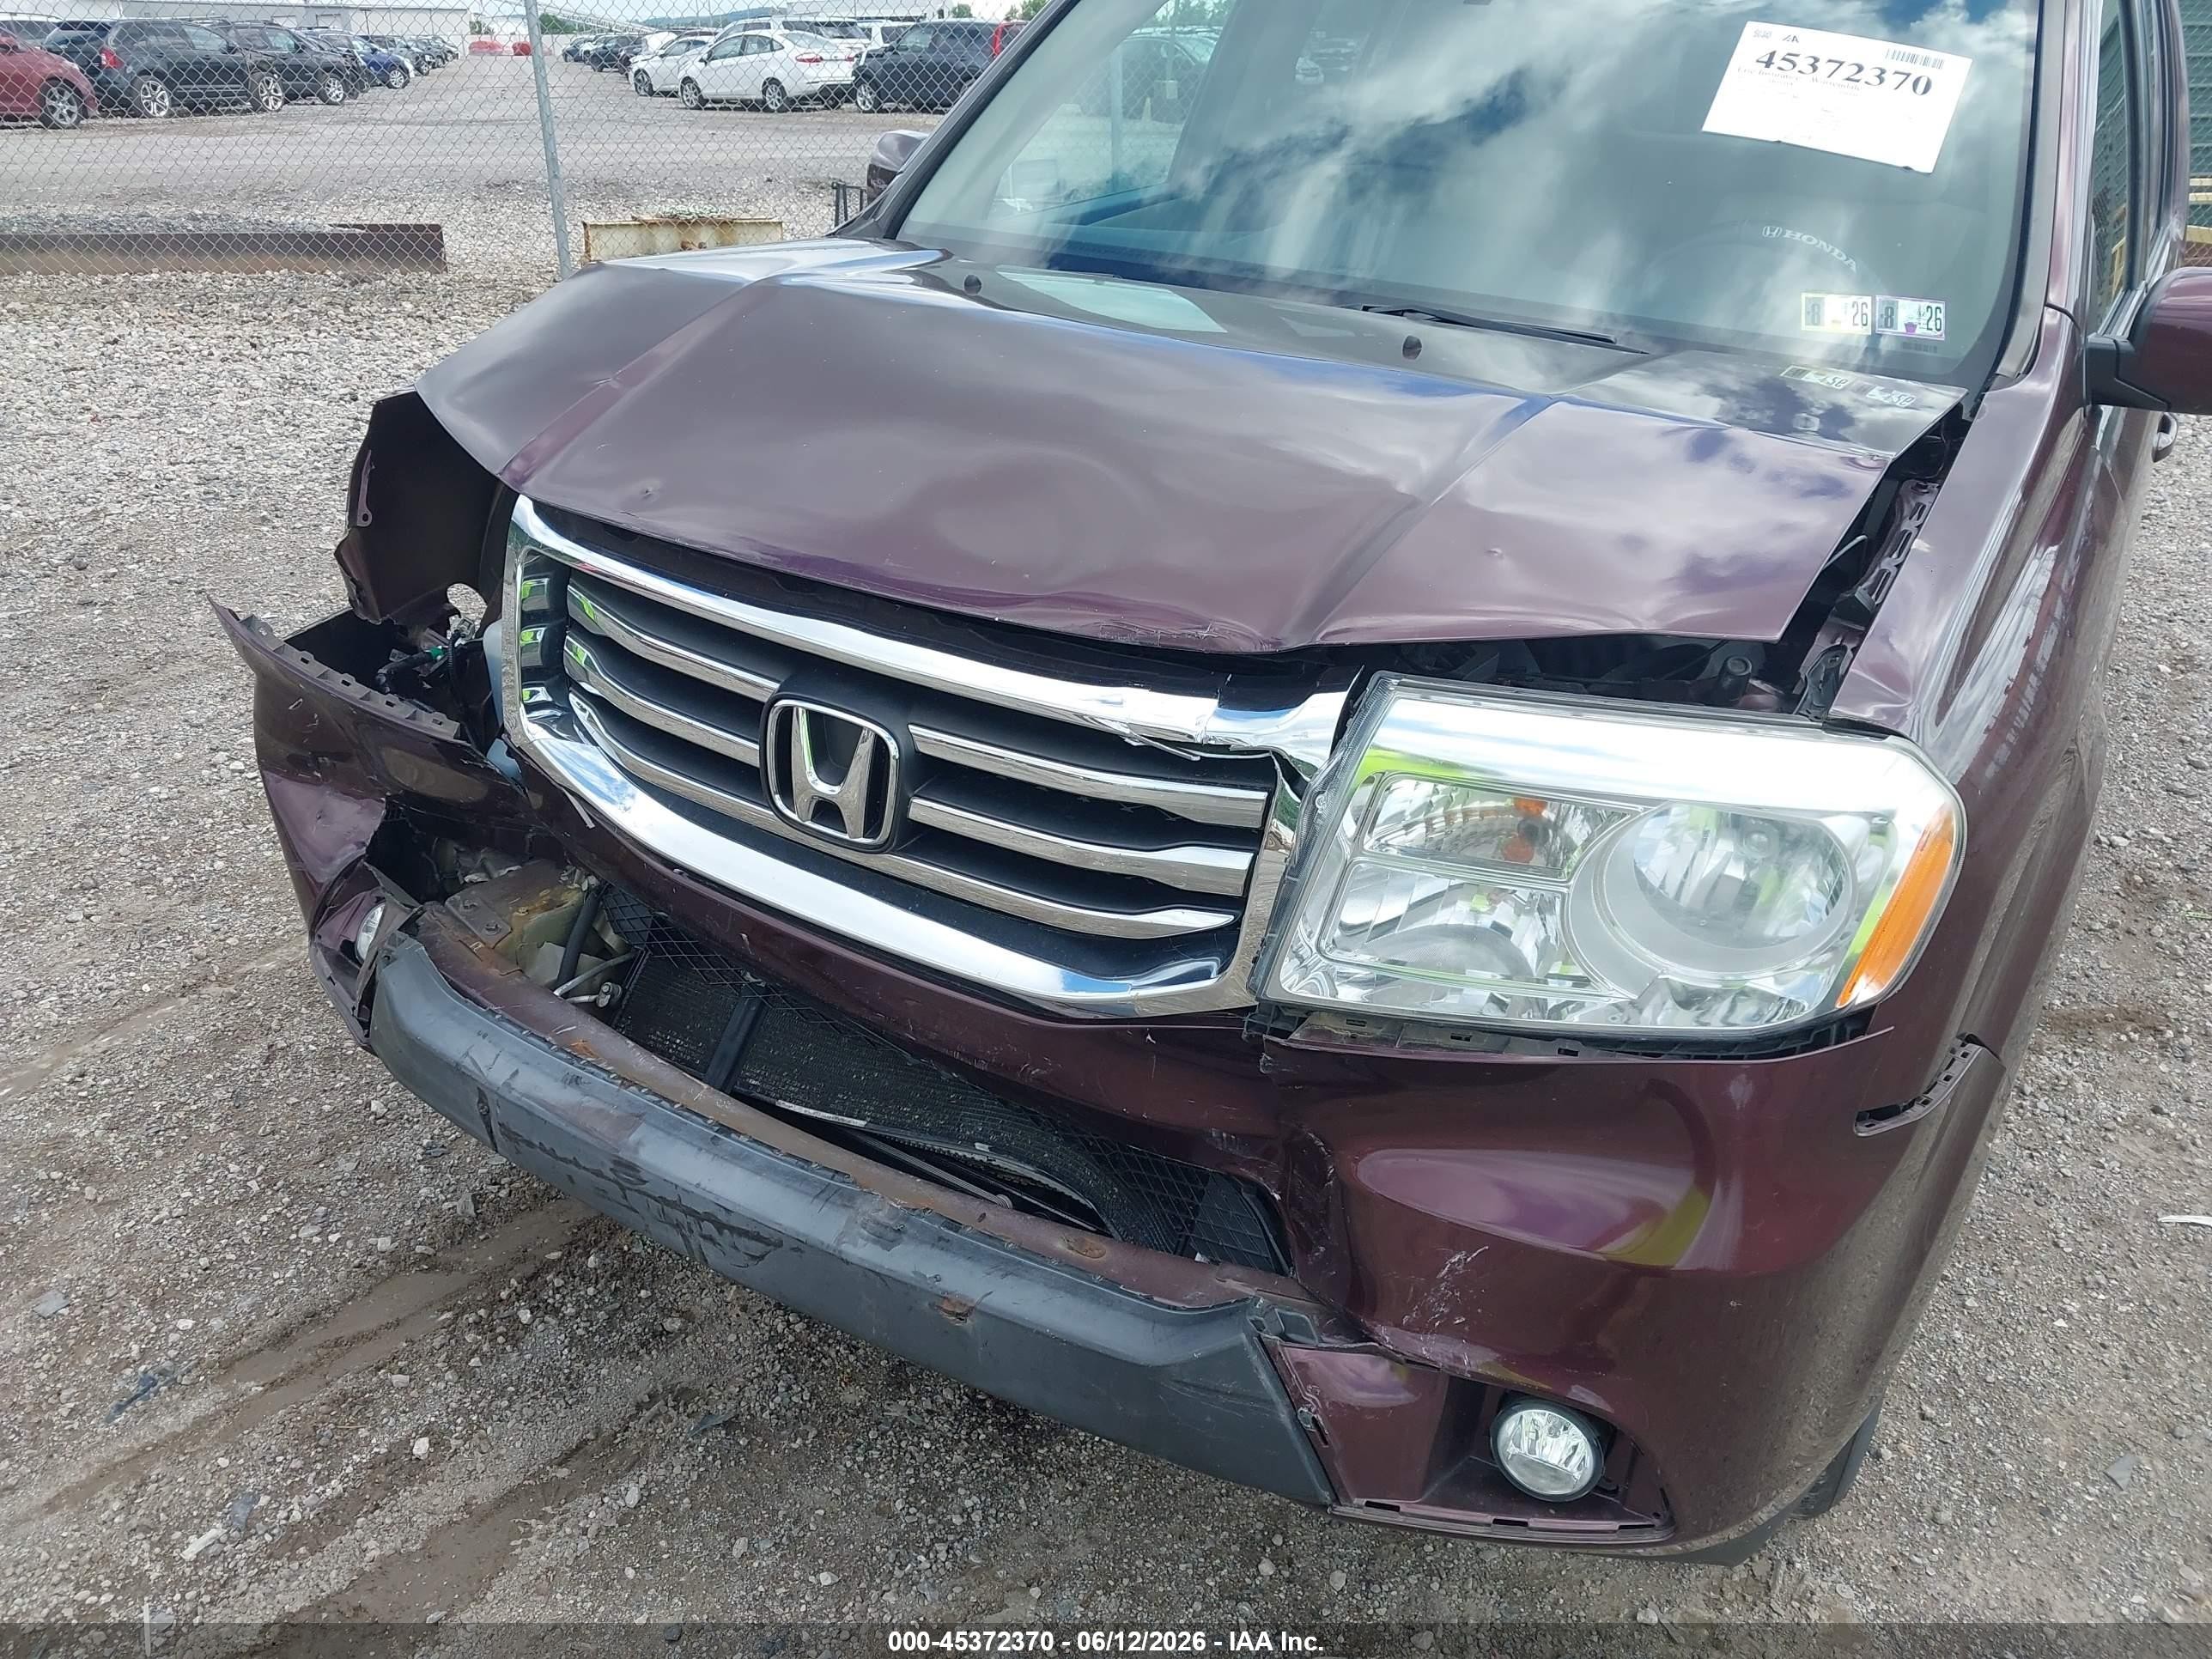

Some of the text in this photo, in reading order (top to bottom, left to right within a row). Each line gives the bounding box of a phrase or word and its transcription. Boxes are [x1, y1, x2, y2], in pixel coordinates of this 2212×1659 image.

[1755, 49, 1933, 96] 45372370
[1784, 229, 1856, 273] HONDA
[1851, 301, 1869, 327] 26
[1925, 305, 1942, 332] 26
